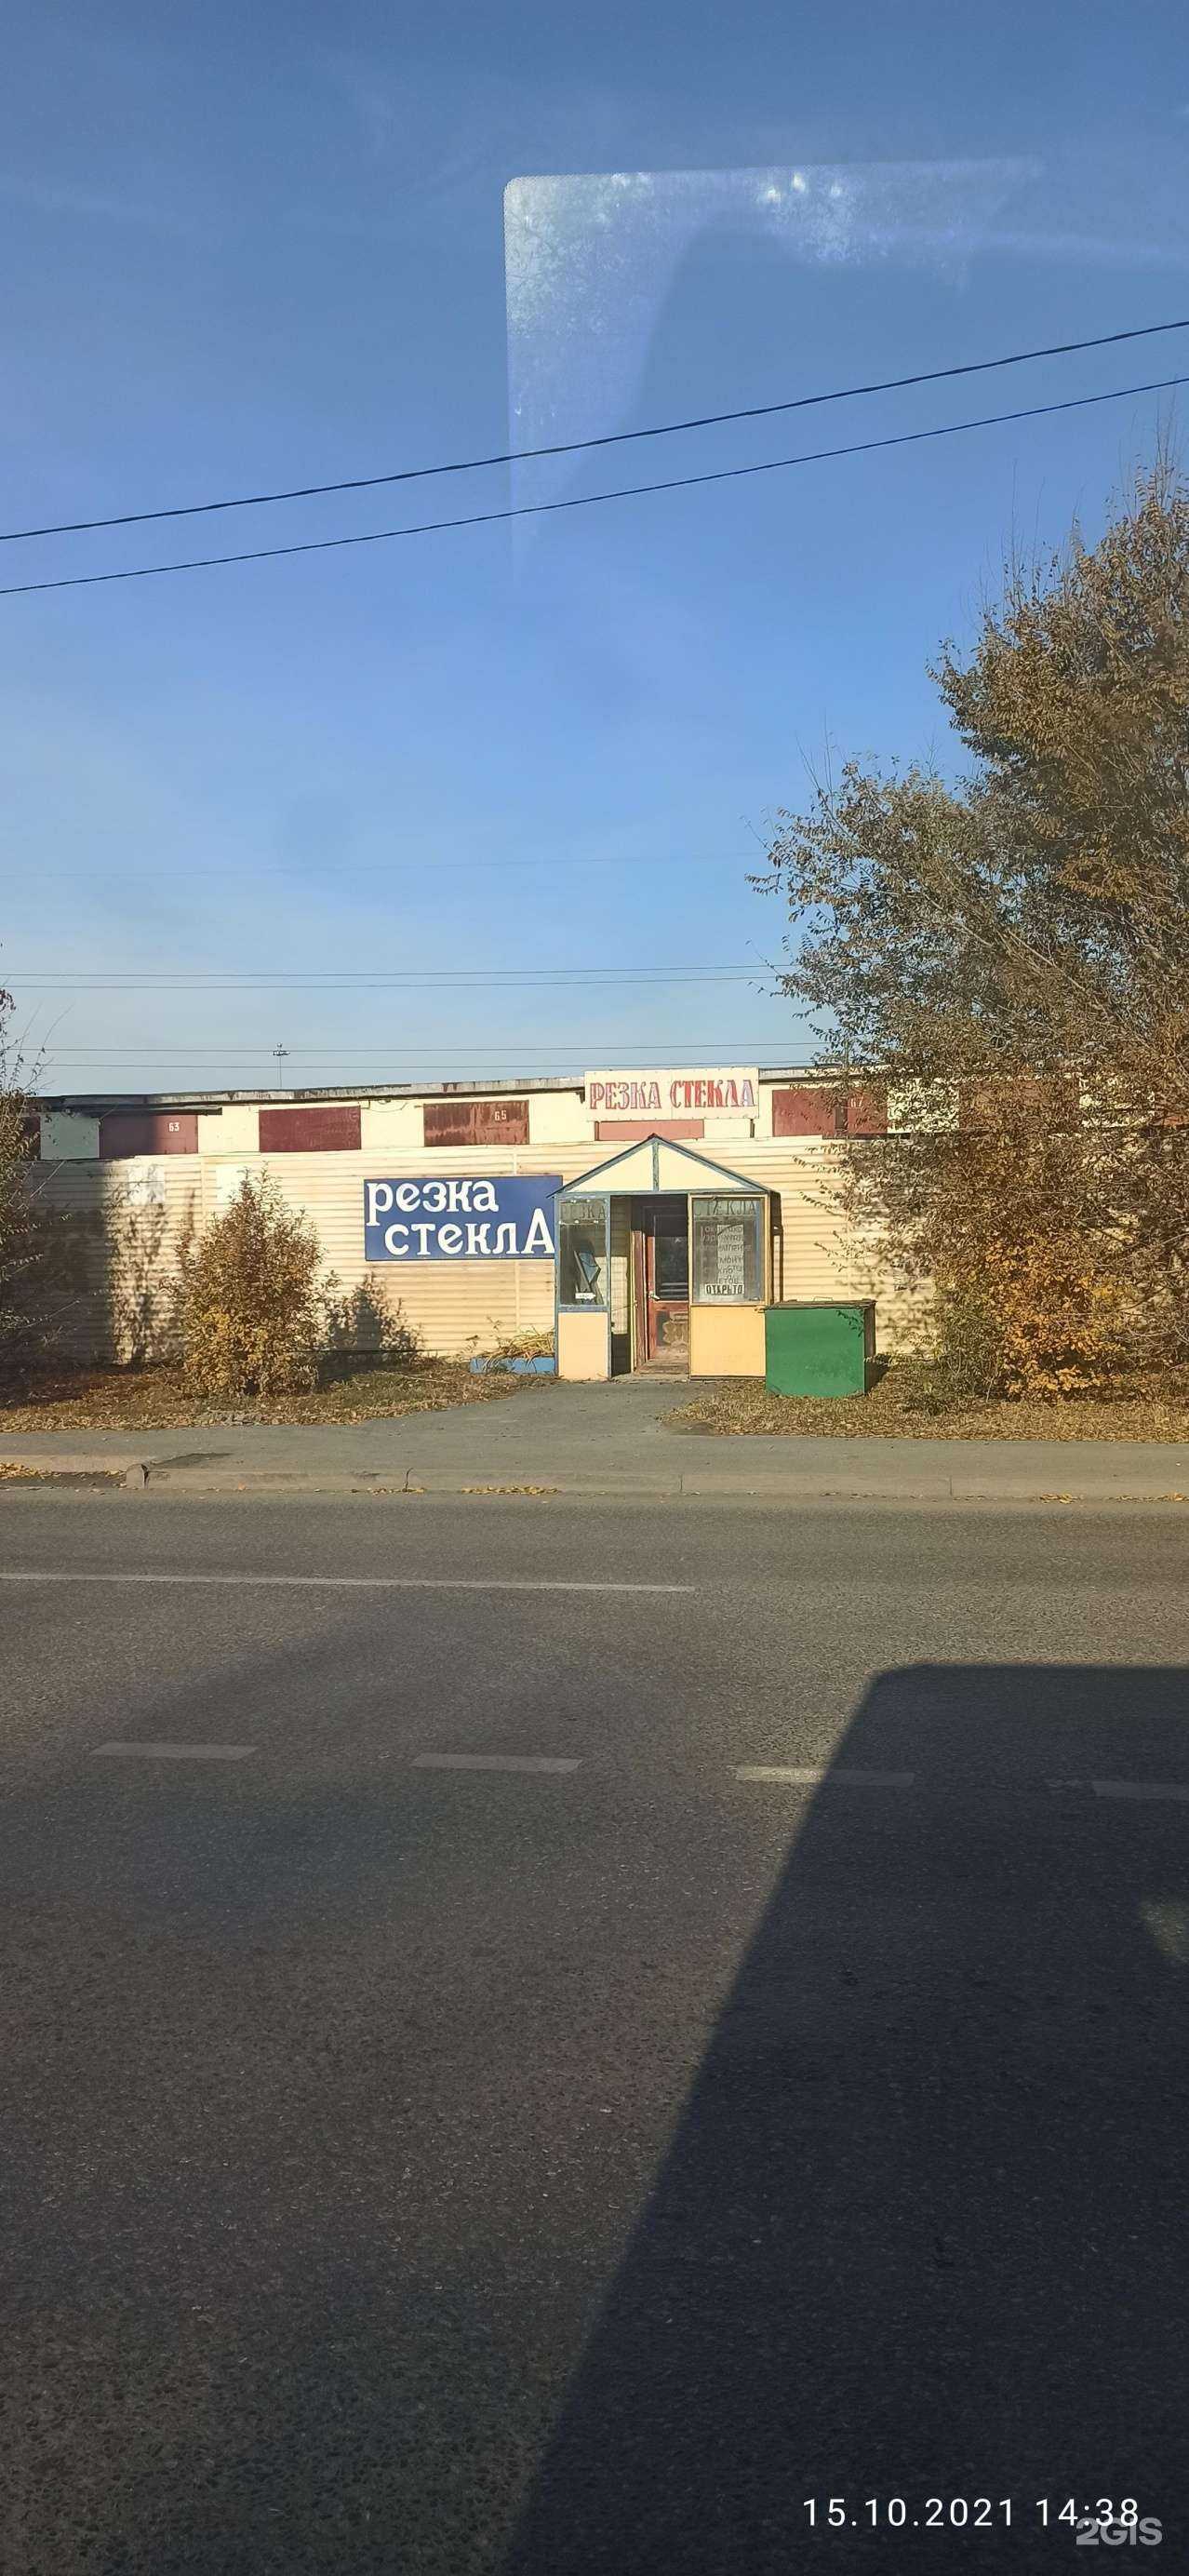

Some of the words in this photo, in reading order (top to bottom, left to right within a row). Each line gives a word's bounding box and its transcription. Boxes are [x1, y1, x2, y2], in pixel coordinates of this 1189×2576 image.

[590, 1081, 661, 1109] РЕЗКА
[670, 1080, 756, 1108] СТЕКЛА
[494, 1109, 507, 1121] 65
[168, 1121, 180, 1132] 63
[367, 1181, 499, 1227] резка
